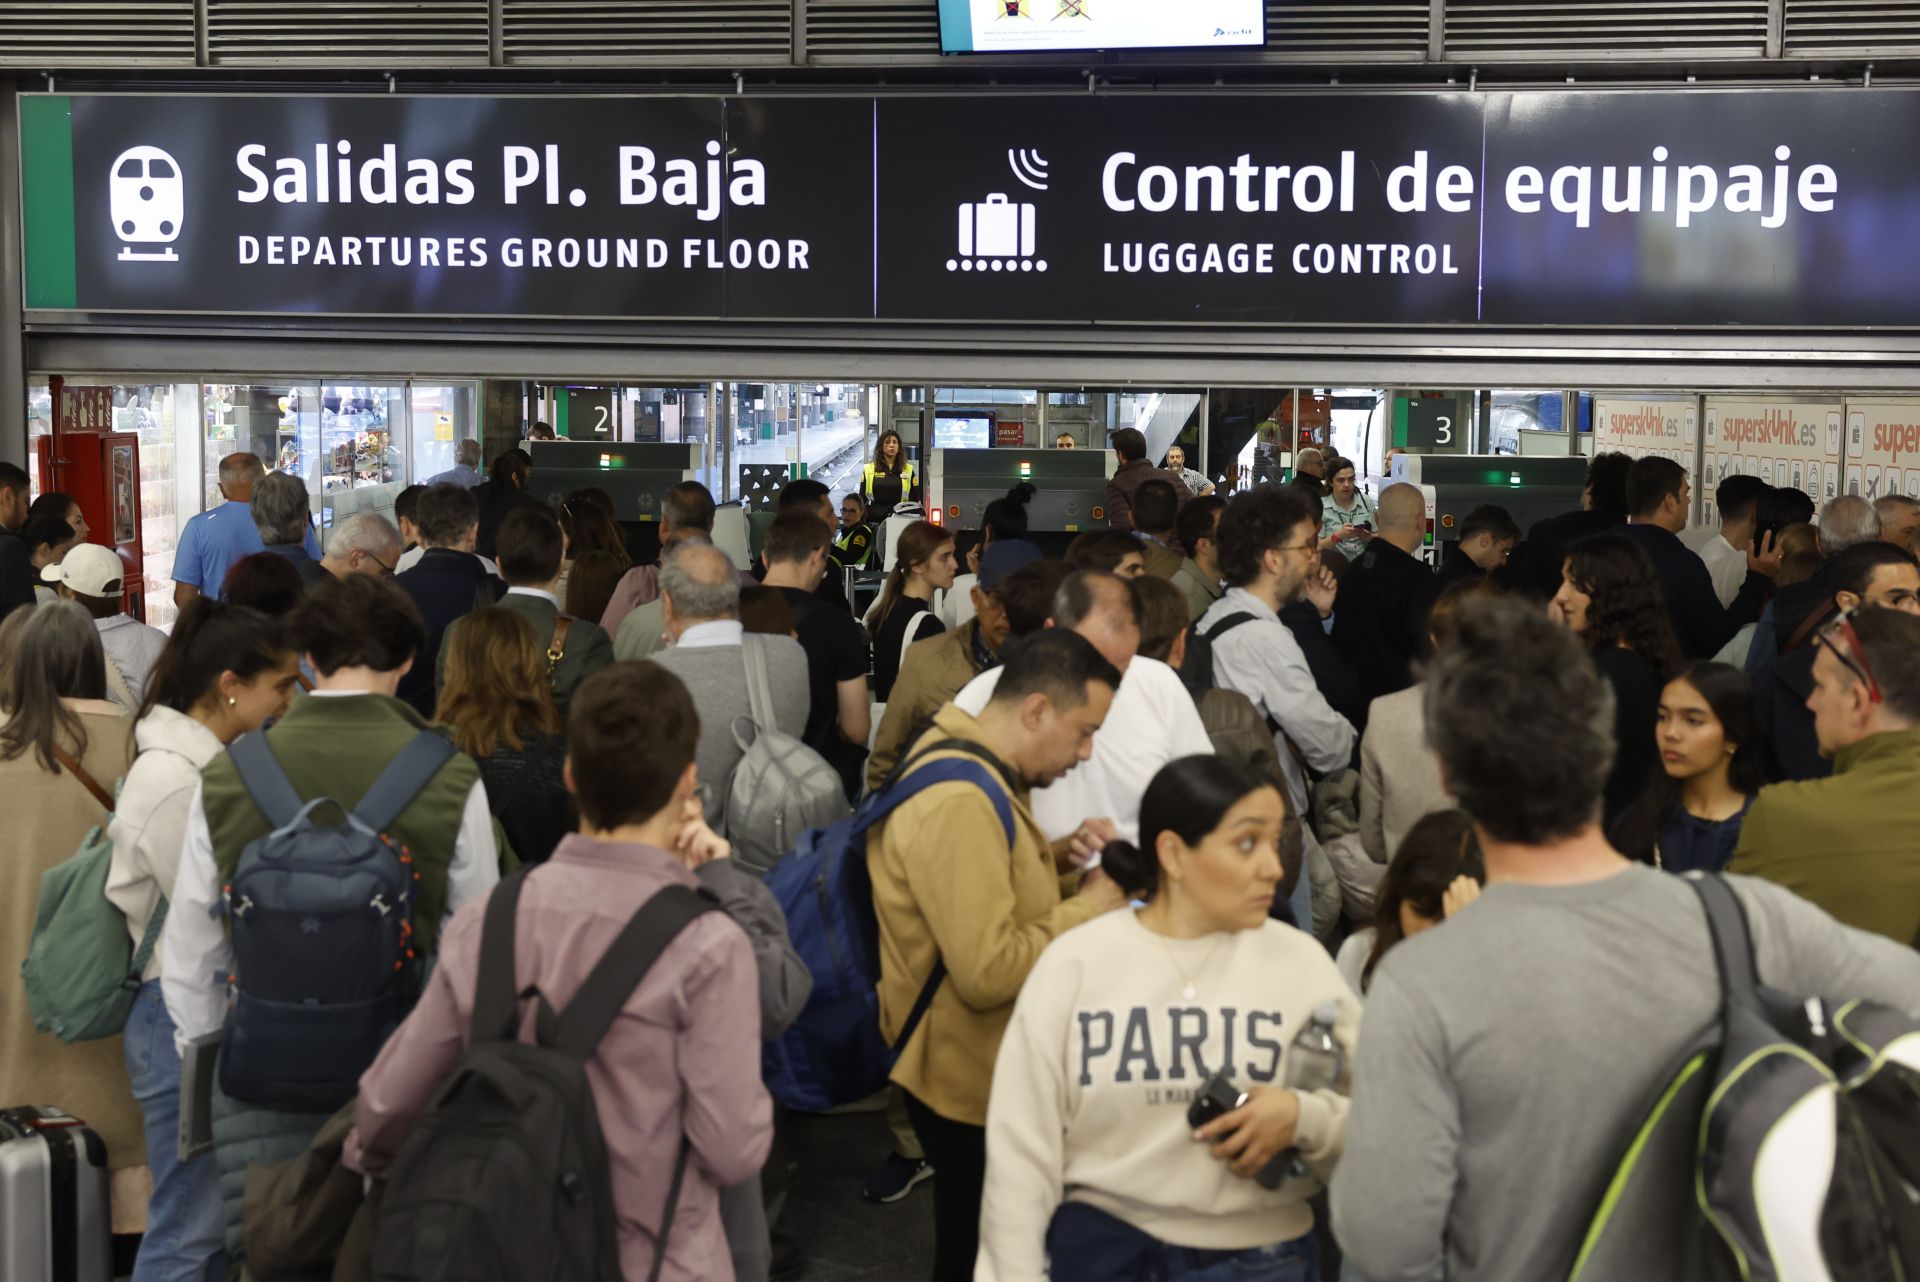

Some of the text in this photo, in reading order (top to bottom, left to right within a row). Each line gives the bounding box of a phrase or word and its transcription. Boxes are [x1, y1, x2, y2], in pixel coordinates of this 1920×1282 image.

[236, 140, 765, 221] Salidas Pl. Baja
[1102, 145, 1838, 229] Control de equipaje
[239, 235, 809, 269] DEPARTURES GROUND FLOOR
[1104, 242, 1459, 274] LUGGAGE CONTROL
[594, 405, 608, 432] 2
[1435, 416, 1451, 444] 3
[1078, 1007, 1282, 1086] PARIS
